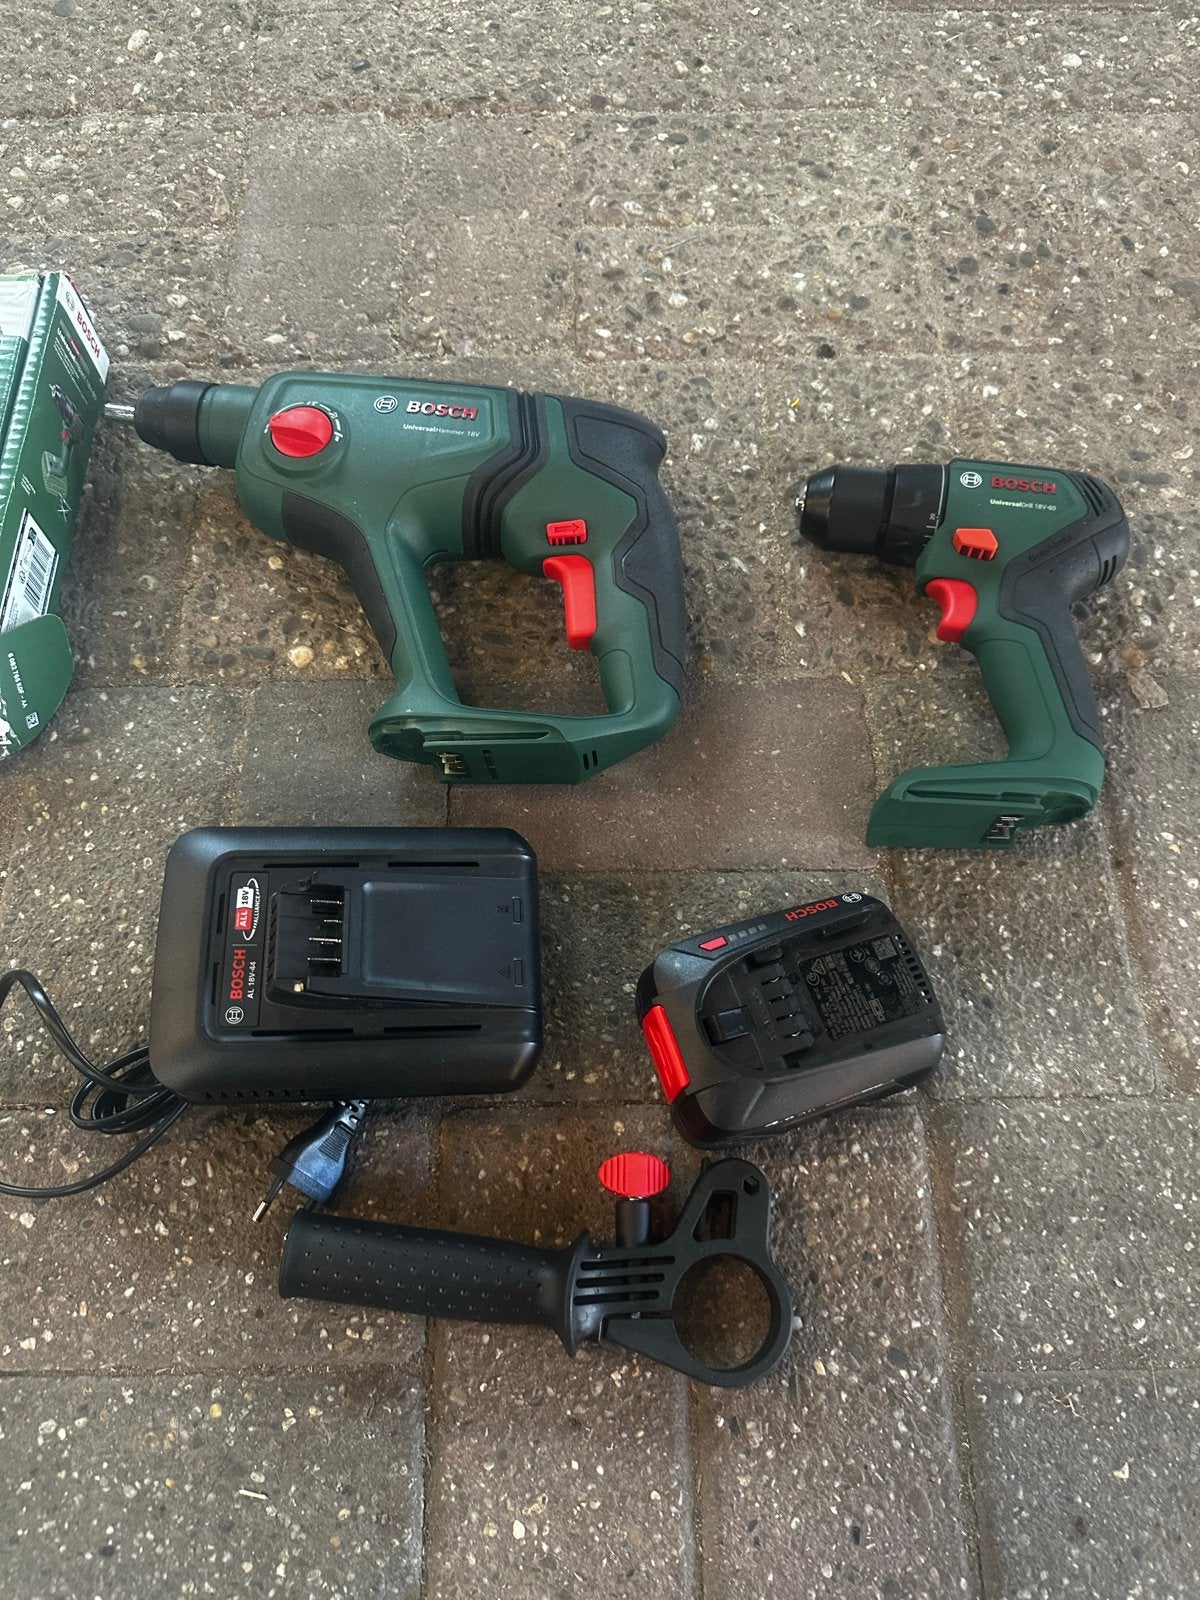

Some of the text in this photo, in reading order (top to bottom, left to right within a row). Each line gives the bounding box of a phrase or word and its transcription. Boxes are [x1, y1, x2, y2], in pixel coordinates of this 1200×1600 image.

[77, 311, 101, 358] BOSCH
[406, 400, 478, 420] BOSCH
[403, 424, 480, 438] UniversalHammer 18V
[991, 476, 1056, 494] BOSCH
[990, 498, 1057, 511] UniversalDrill 18V-60
[240, 890, 249, 927] ALL 18V
[784, 900, 839, 921] BOSCH
[230, 949, 246, 999] BOSCH
[247, 961, 257, 999] AL 18V-44
